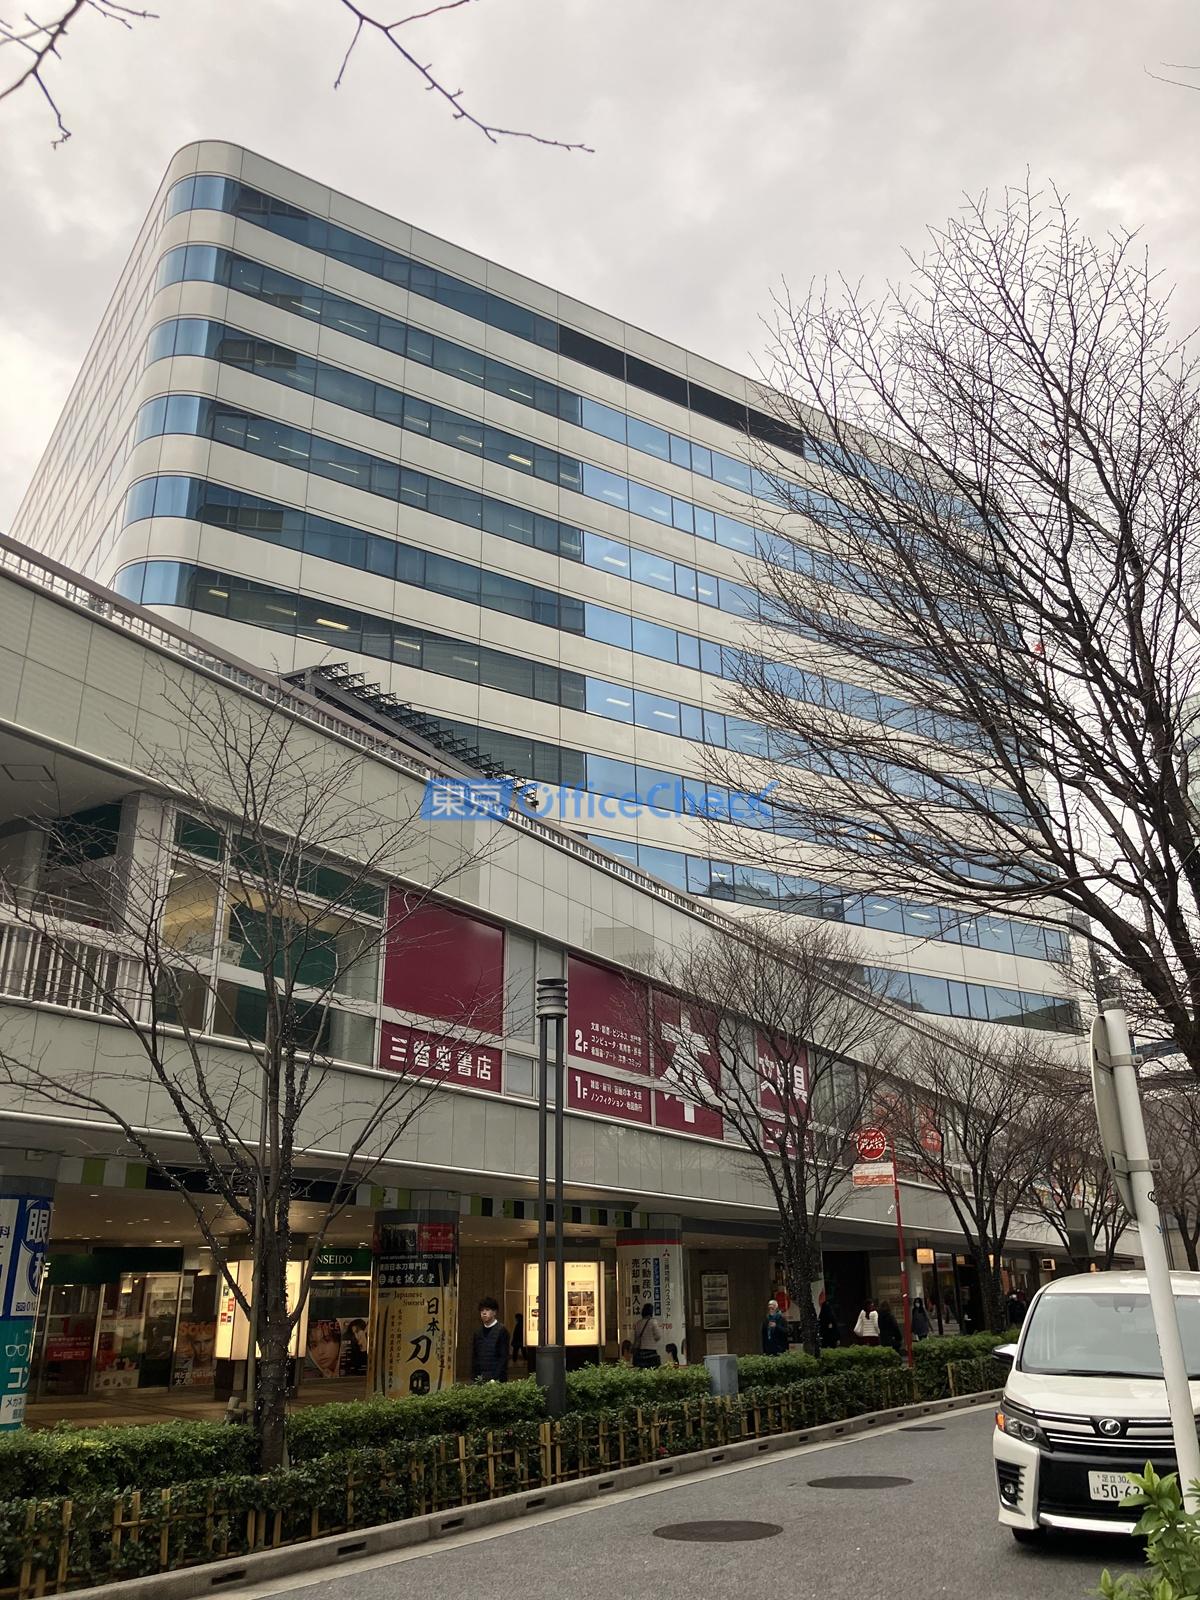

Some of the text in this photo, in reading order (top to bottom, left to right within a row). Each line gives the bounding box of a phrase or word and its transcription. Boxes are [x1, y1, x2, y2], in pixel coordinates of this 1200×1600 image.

[575, 1029, 588, 1053] 2F
[390, 1036, 491, 1080] 三省堂書店
[659, 1003, 718, 1124] 本
[575, 1076, 588, 1099] 1F
[316, 1254, 353, 1265] NSEIDO
